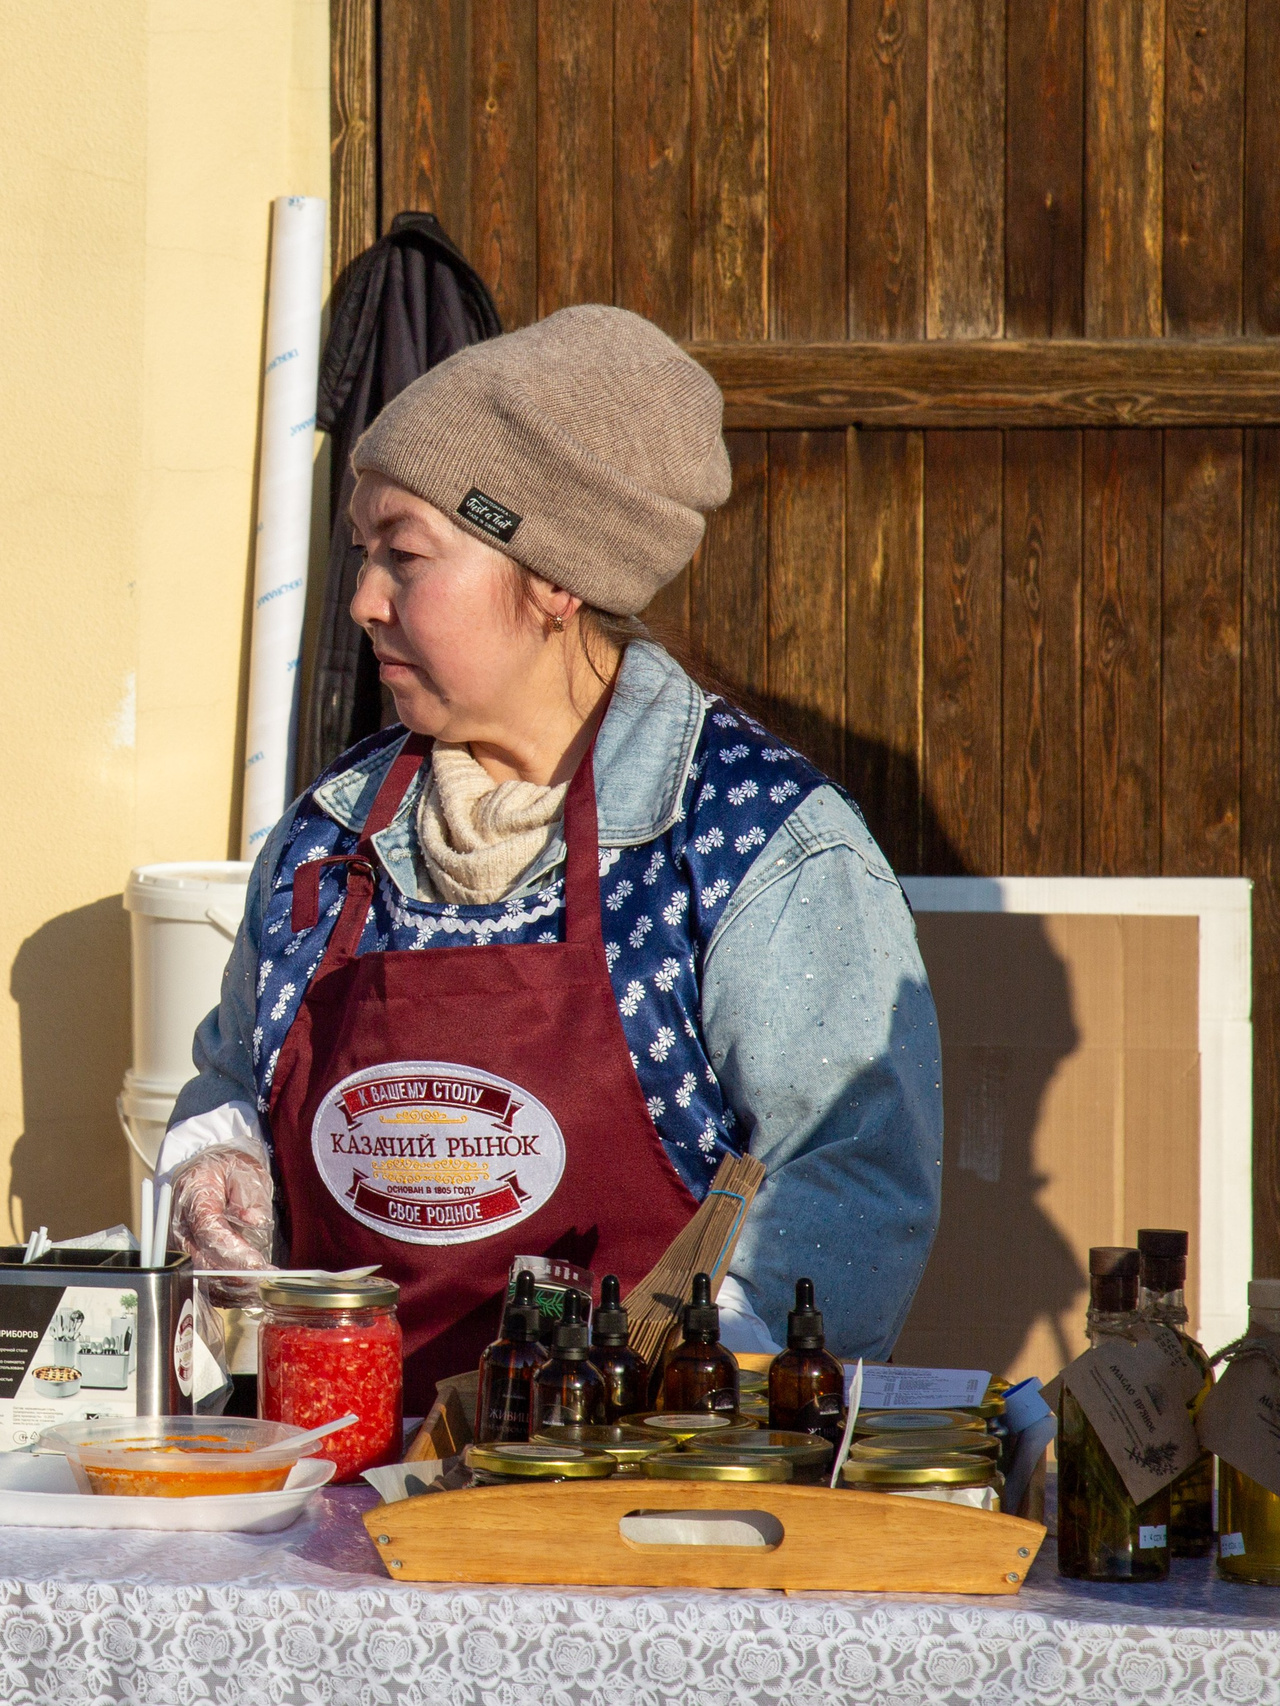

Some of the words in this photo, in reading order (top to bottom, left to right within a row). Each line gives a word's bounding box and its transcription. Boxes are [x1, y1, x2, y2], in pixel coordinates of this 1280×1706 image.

[466, 497, 489, 515] Just
[484, 512, 492, 520] a
[357, 1091, 368, 1106] К
[370, 1082, 427, 1101] ВАШЕМУ
[432, 1082, 484, 1104] СТОЛУ
[330, 1133, 436, 1158] КАЗАЧИЙ
[445, 1135, 541, 1158] РЫНОК
[387, 1185, 424, 1195] ОСНОВАН
[426, 1186, 432, 1194] В
[434, 1186, 452, 1195] 1805
[453, 1186, 476, 1196] ГОДУ
[388, 1201, 421, 1223] СВОЕ
[426, 1203, 483, 1225] РОДНОЕ
